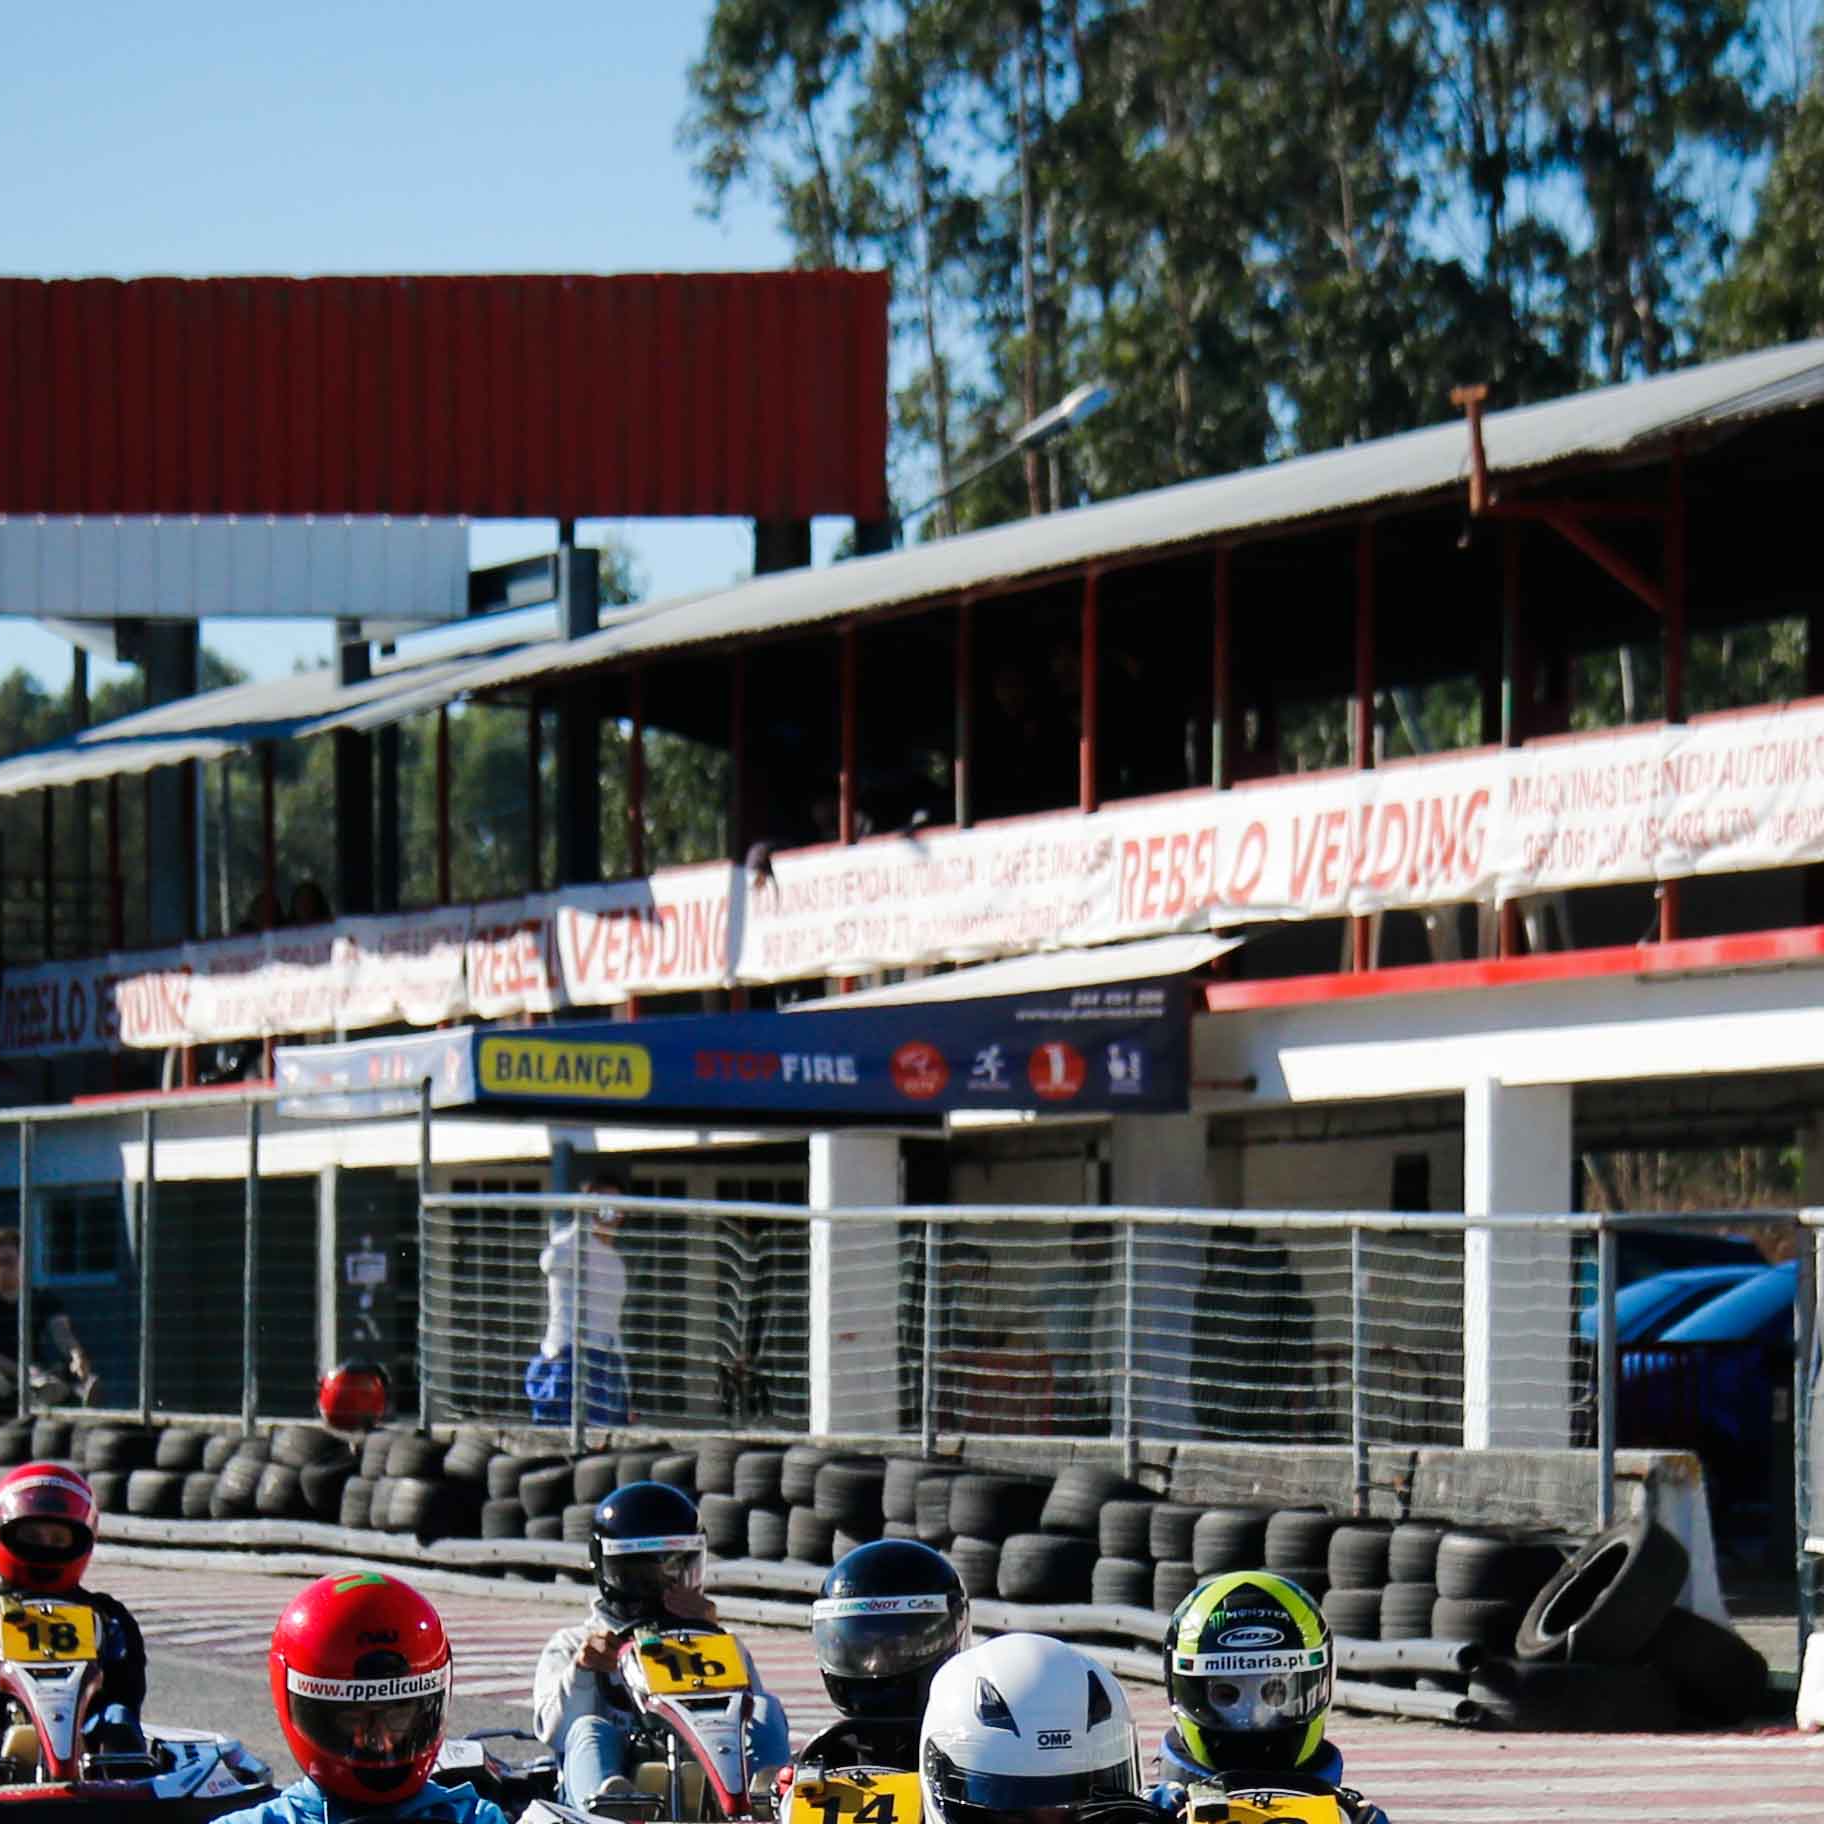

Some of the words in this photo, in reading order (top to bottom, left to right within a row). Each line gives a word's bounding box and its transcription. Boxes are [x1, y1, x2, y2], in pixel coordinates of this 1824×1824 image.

[1288, 788, 1491, 900] VENDING
[568, 893, 729, 986] VENDING
[494, 1049, 633, 1092] BALANÇA
[19, 1620, 80, 1653] 18
[1204, 1653, 1306, 1672] militaria.pt
[1037, 1733, 1072, 1747] OMP
